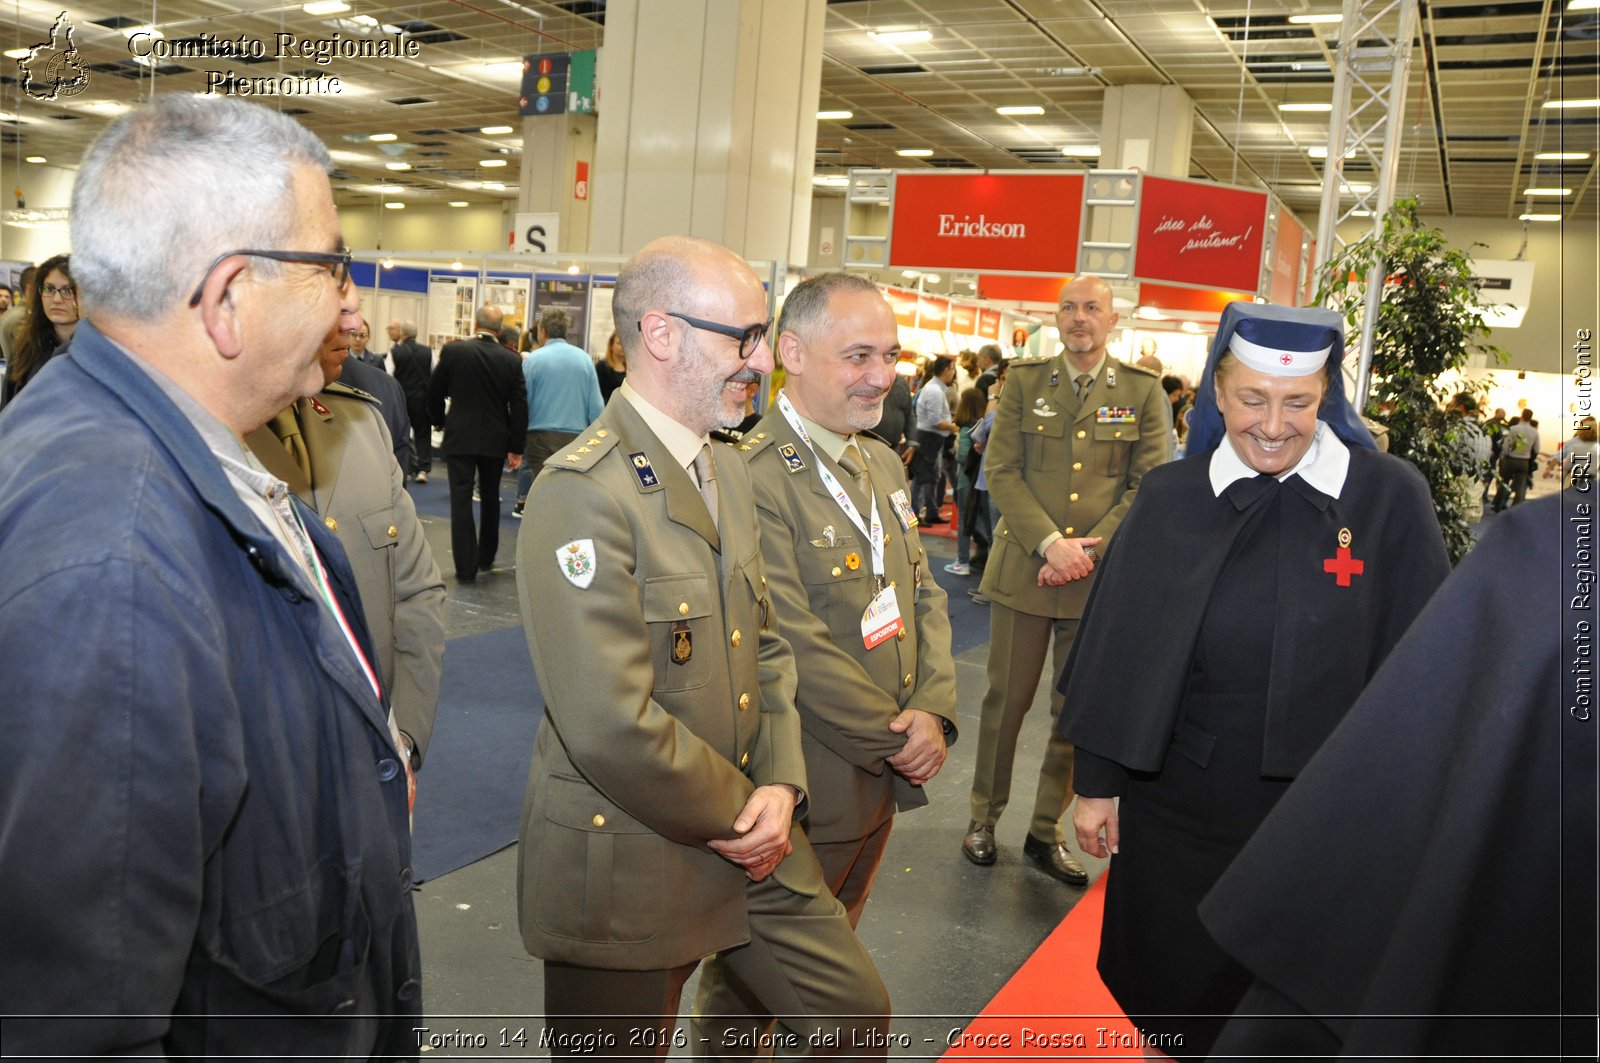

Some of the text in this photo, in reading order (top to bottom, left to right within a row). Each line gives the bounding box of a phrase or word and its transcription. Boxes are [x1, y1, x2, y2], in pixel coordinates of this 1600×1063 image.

[937, 213, 1026, 239] Erickson
[1153, 214, 1214, 234] idee che
[526, 224, 547, 253] S
[1179, 225, 1253, 254] aiutano!
[870, 621, 899, 643] ESPOSITORE
